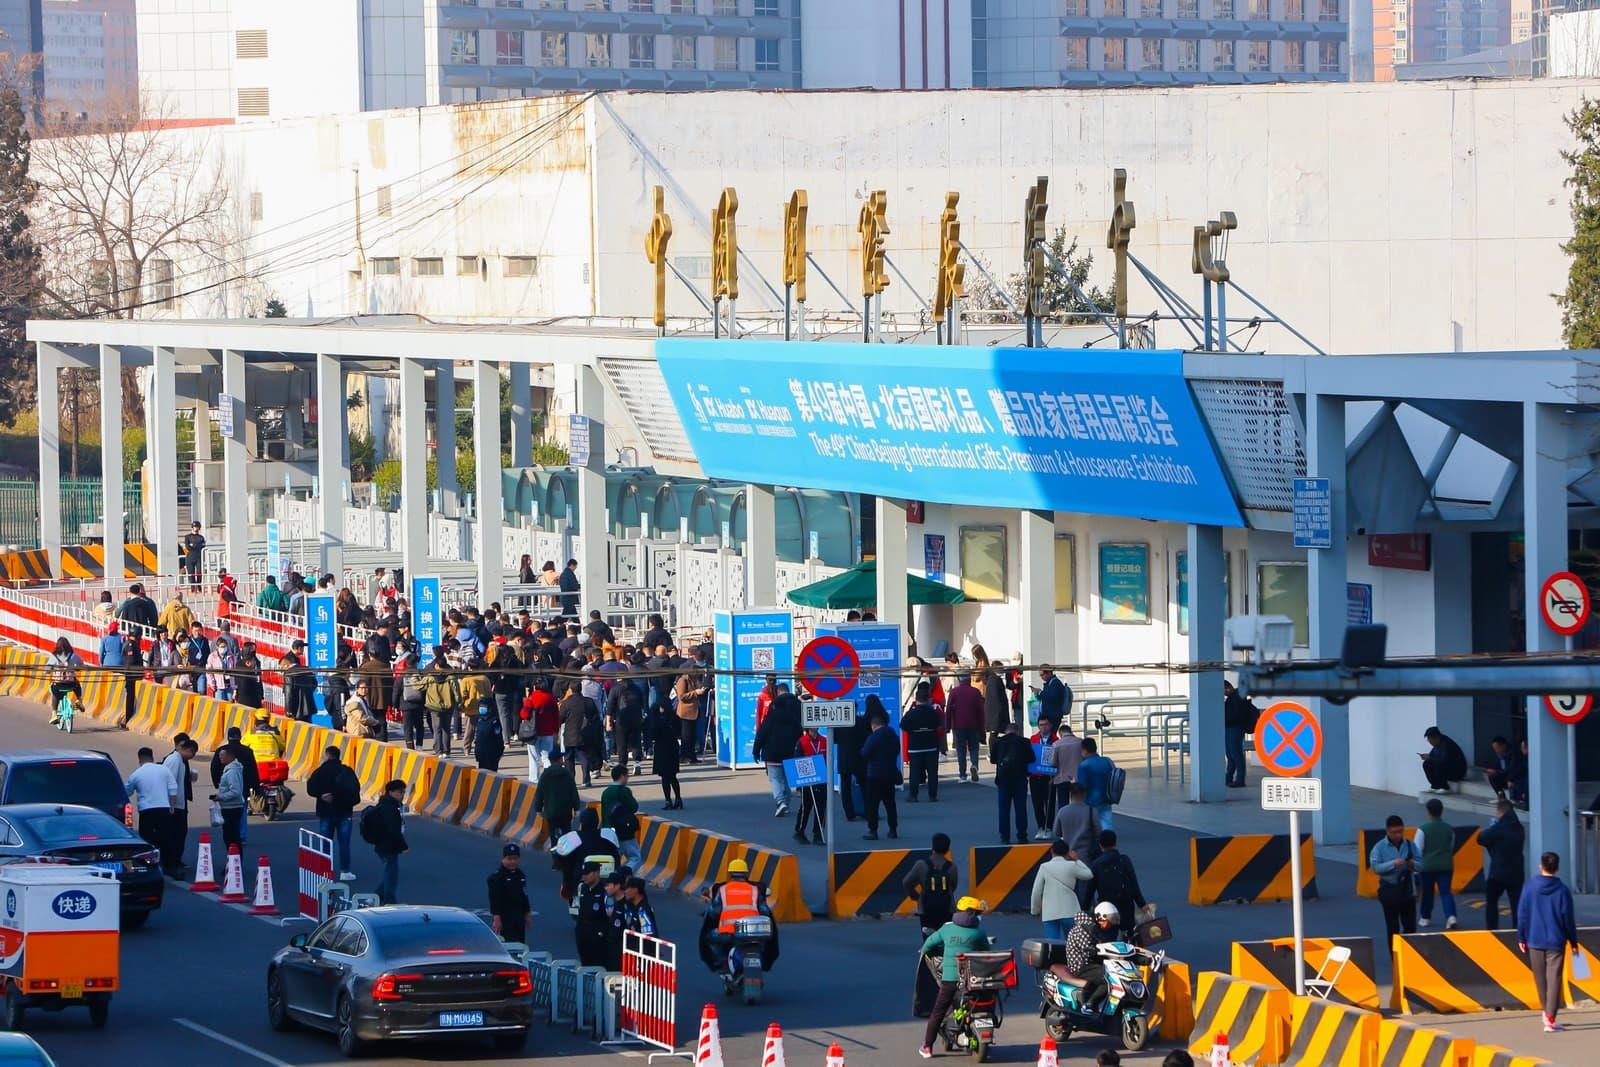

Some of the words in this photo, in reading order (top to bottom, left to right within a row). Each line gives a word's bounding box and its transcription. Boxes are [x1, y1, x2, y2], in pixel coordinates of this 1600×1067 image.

[808, 431, 834, 458] The
[845, 434, 875, 462] China
[870, 437, 913, 472] Beijing
[904, 441, 980, 470] International
[1055, 449, 1072, 476] &
[1065, 450, 1137, 480] Houseware
[1130, 453, 1198, 486] Exhibition
[807, 705, 851, 722] 国展中心门前
[1267, 784, 1316, 804] 国展中心门前
[57, 896, 92, 914] 快递
